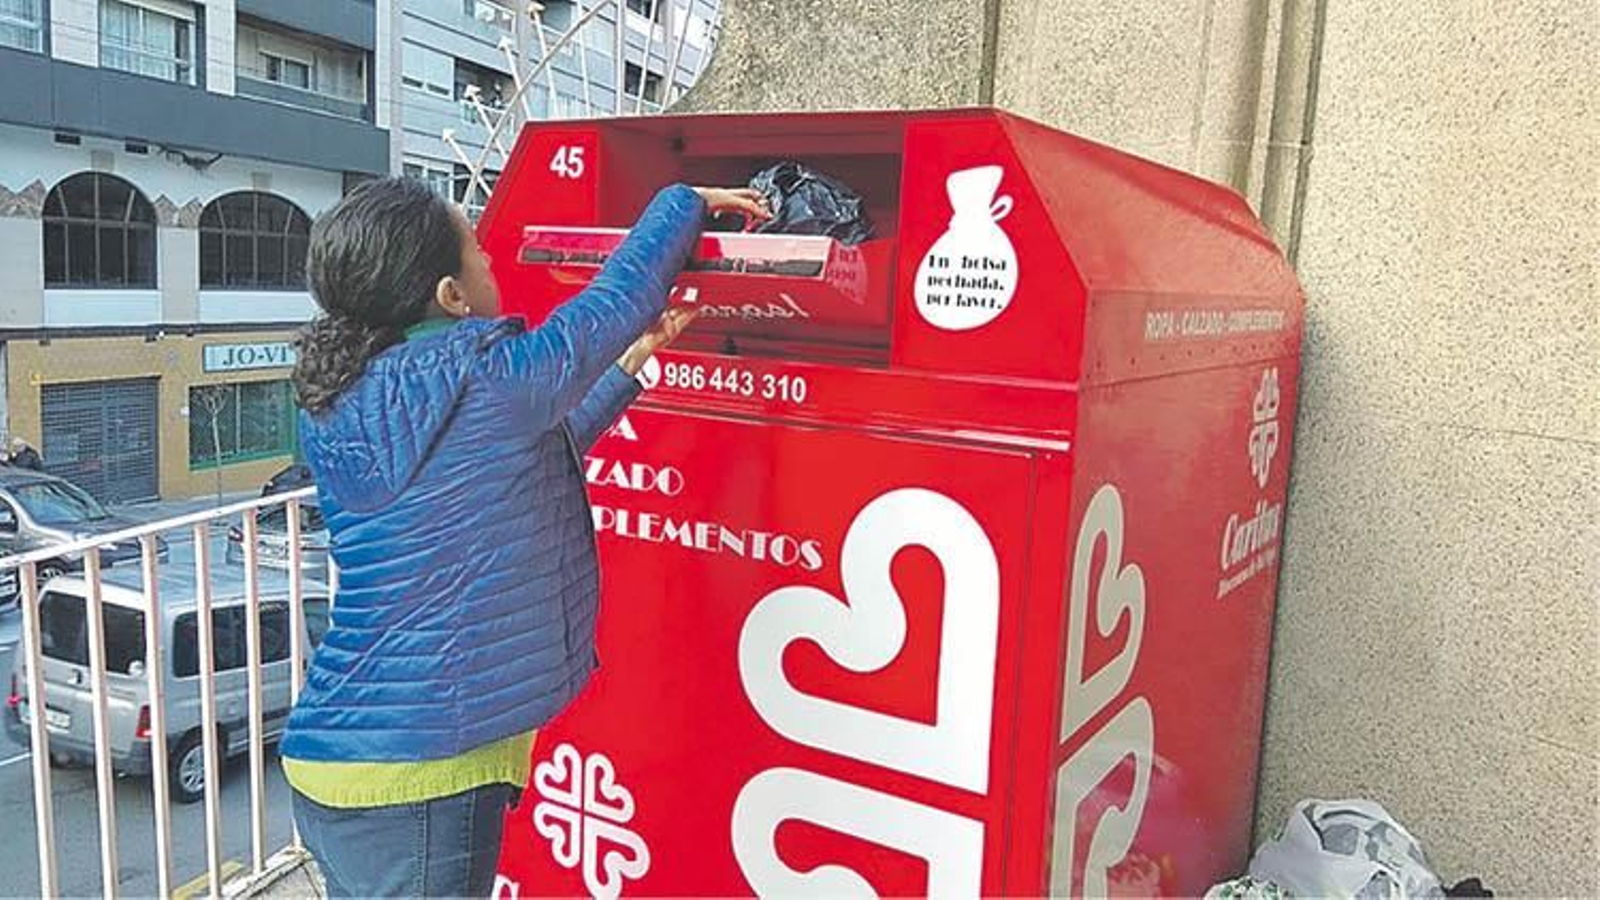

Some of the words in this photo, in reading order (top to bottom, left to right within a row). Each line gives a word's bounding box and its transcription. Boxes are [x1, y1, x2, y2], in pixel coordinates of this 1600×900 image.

[549, 145, 585, 179] 45
[1145, 311, 1174, 341] ROPA
[664, 362, 705, 390] 986
[708, 366, 754, 397] 443
[761, 373, 807, 404] 310
[583, 455, 685, 497] ZADO
[590, 504, 823, 571] PLEMENTOS
